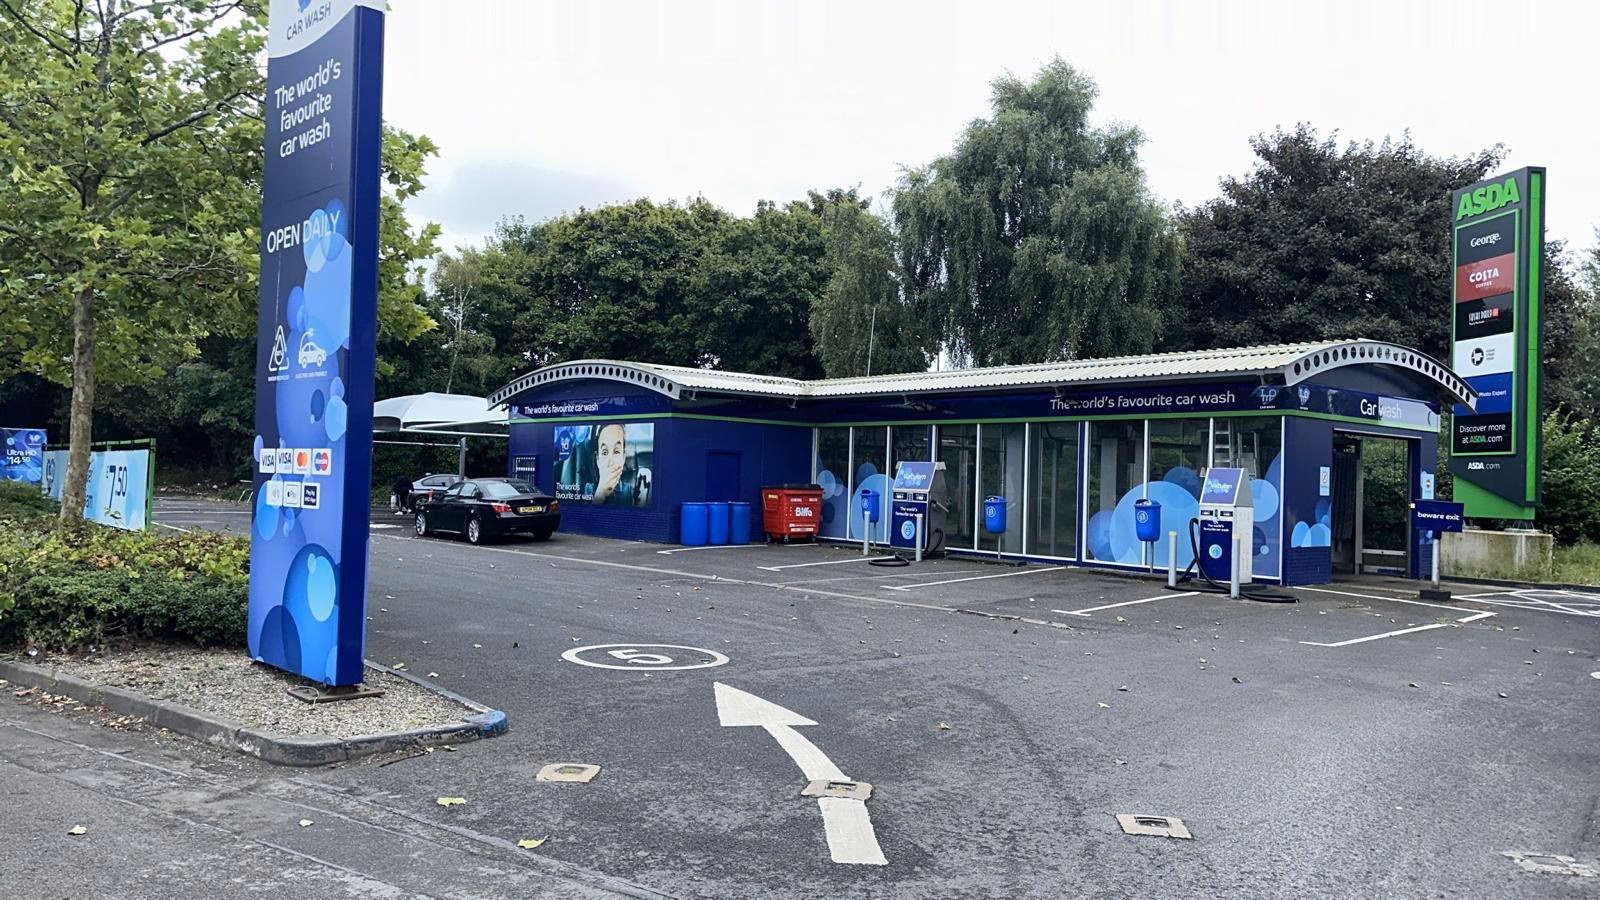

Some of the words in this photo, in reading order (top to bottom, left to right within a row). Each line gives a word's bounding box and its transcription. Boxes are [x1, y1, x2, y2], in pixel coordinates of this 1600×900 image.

[287, 19, 303, 40] CAR
[304, 1, 331, 29] WASH
[274, 85, 294, 108] The
[296, 58, 340, 98] world's
[280, 93, 332, 132] favourite
[280, 134, 298, 157] car
[300, 117, 330, 150] wash
[1456, 178, 1520, 221] ASDA
[267, 223, 300, 252] OPEN
[302, 210, 340, 242] DAILY
[1469, 268, 1499, 282] COSTA
[1050, 399, 1070, 410] The
[1117, 394, 1172, 408] favourite
[1175, 396, 1196, 405] car
[1199, 390, 1235, 404] wash
[1492, 390, 1507, 398] Expert
[524, 406, 533, 414] The
[534, 404, 552, 414] world's
[552, 404, 574, 413] favourite
[584, 402, 598, 411] wash
[1360, 398, 1377, 416] Car
[1378, 402, 1402, 419] wash
[1460, 424, 1487, 433] Discover
[262, 455, 274, 466] VISA
[278, 452, 292, 464] VISA
[795, 507, 812, 516] Biffa
[1417, 512, 1444, 520] beware
[608, 650, 673, 664] 5
